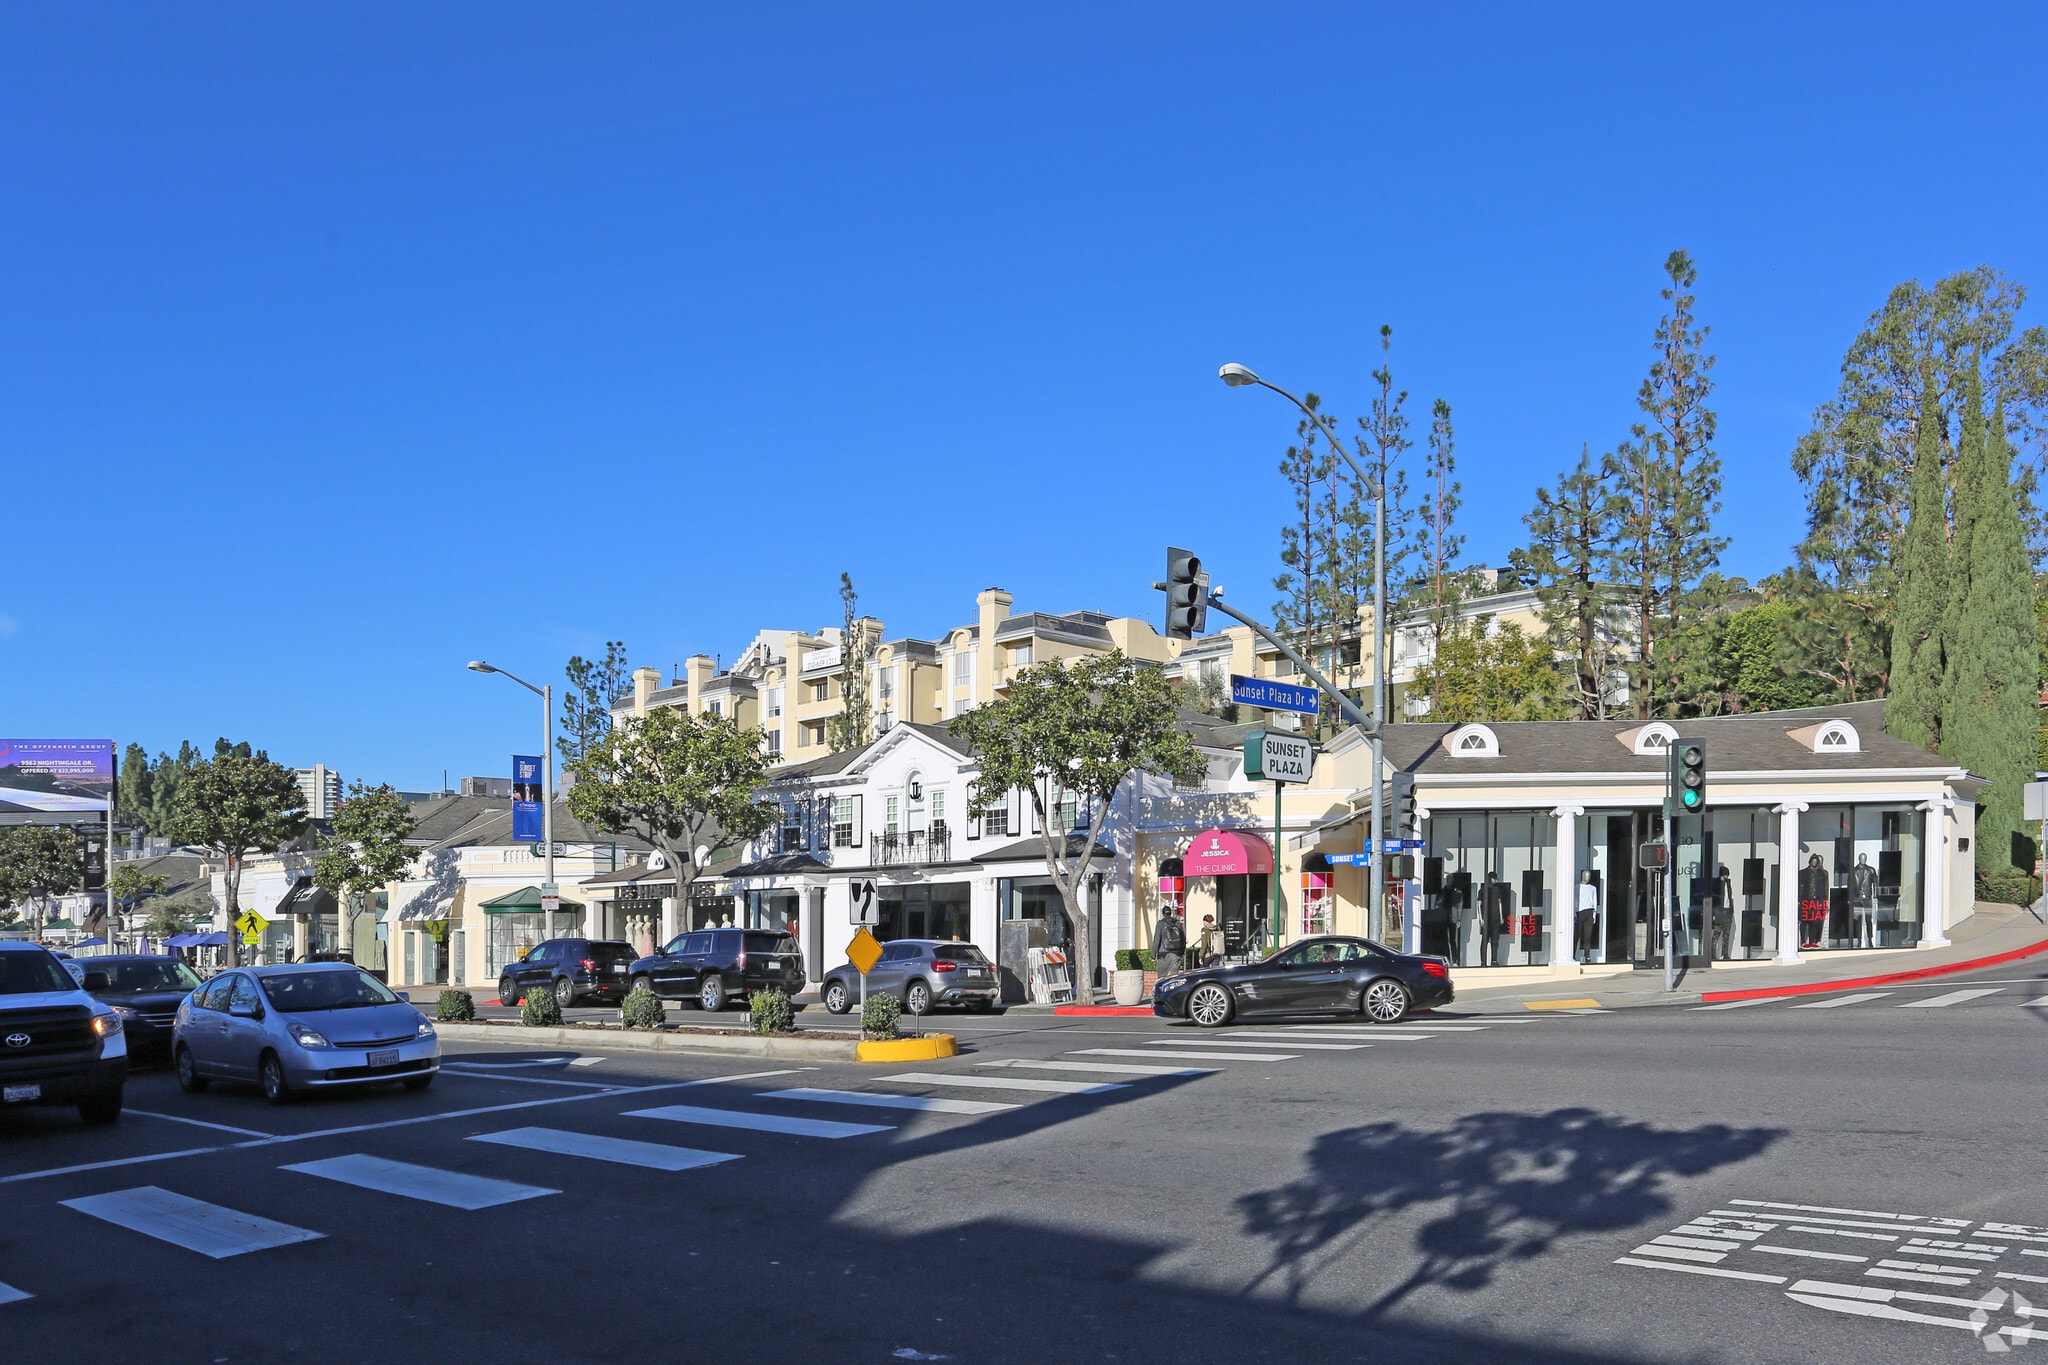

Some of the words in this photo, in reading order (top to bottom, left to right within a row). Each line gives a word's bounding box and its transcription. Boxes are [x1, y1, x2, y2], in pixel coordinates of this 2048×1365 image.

[1234, 683, 1265, 700] Sunset
[1269, 688, 1292, 704] Plaza
[1295, 692, 1305, 706] Dr
[1265, 740, 1306, 759] SUNSET
[519, 764, 536, 772] SUNSET
[1269, 759, 1304, 776] PLAZA
[519, 771, 533, 779] STRIP
[1200, 849, 1230, 858] JESSICA
[1331, 854, 1353, 863] SUNSET
[1195, 865, 1210, 873] THE
[1211, 863, 1237, 872] CLINIC
[1801, 899, 1829, 911] SALE
